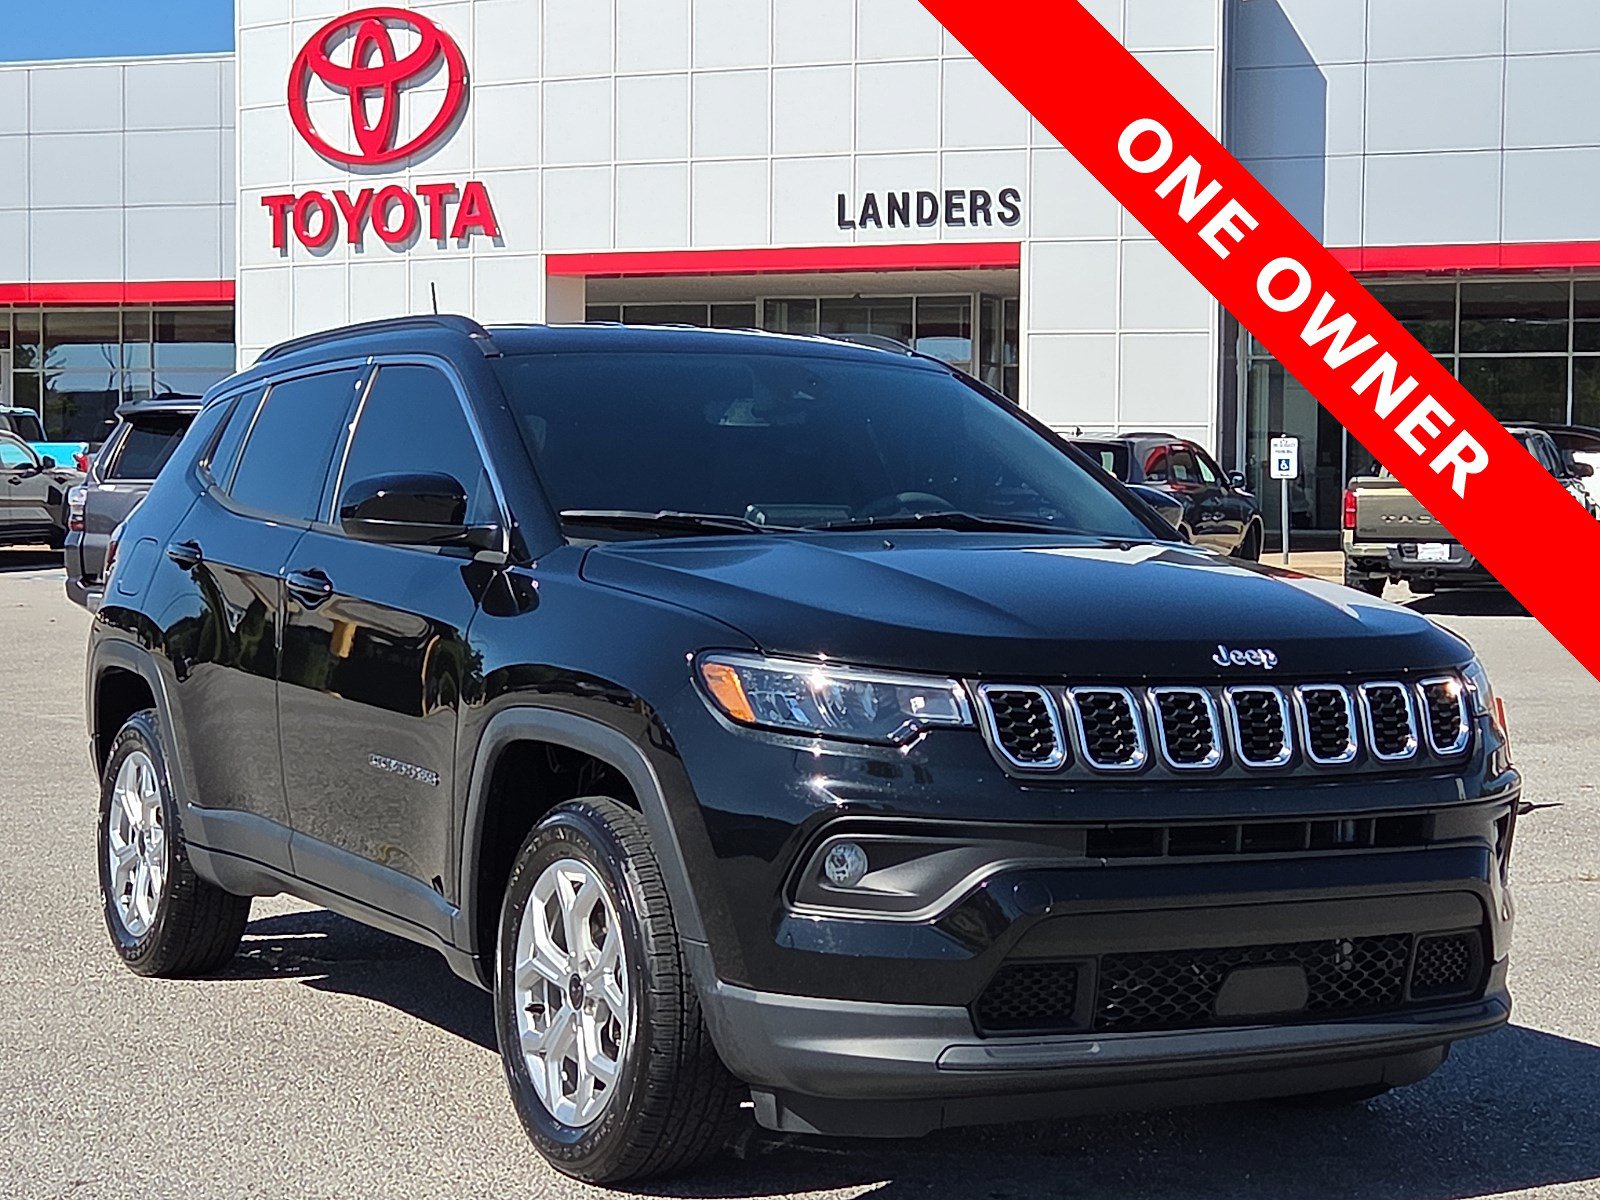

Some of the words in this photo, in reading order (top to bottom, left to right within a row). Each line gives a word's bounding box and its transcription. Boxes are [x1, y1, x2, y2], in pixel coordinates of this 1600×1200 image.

[261, 181, 501, 249] TOYOTA
[838, 188, 1021, 229] LANDERS
[1380, 514, 1441, 524] TAC
[1212, 644, 1278, 670] Jeep
